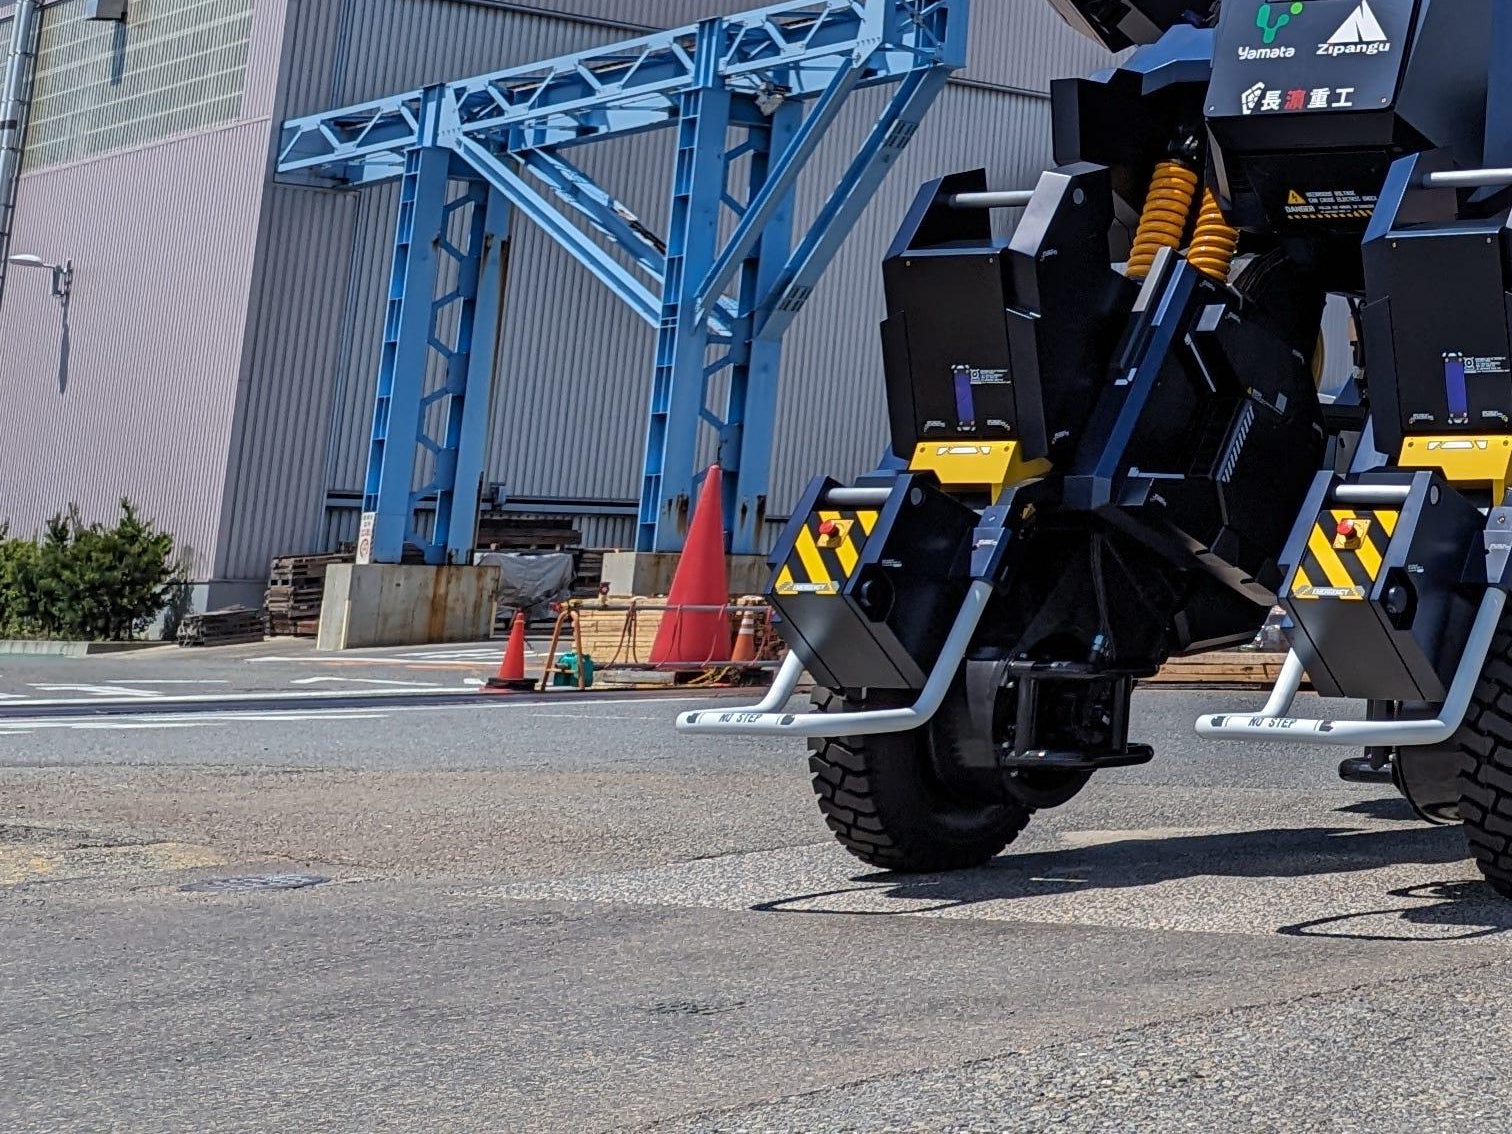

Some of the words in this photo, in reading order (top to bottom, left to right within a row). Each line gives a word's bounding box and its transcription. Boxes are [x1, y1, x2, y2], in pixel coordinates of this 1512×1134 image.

[1237, 45, 1296, 61] Yamata
[1315, 41, 1391, 57] Zipangu
[736, 713, 763, 723] STEP
[1268, 717, 1298, 729] STEP
